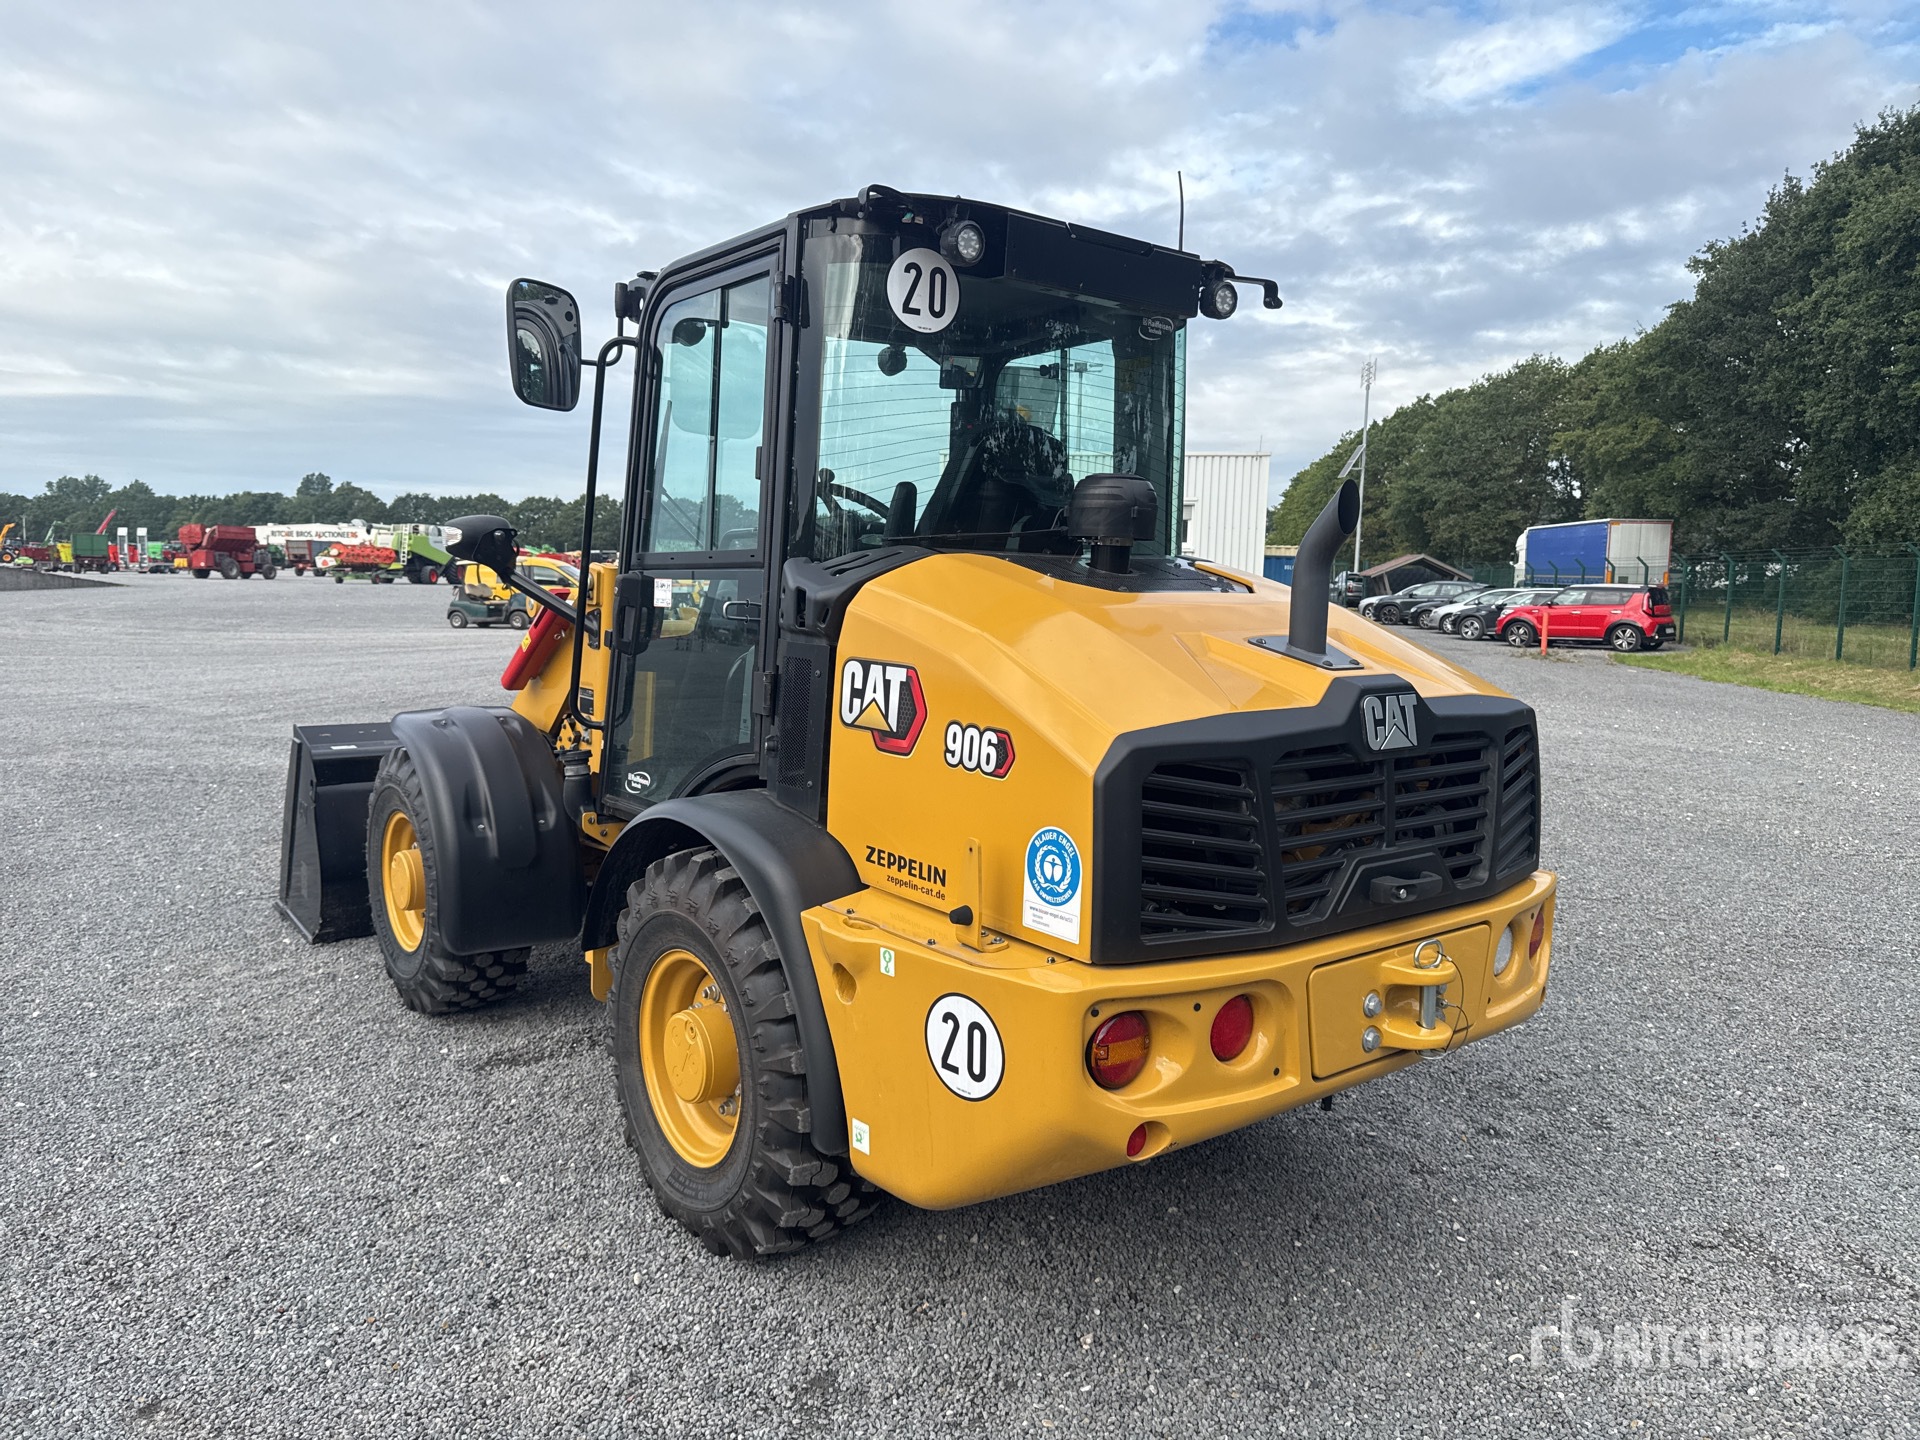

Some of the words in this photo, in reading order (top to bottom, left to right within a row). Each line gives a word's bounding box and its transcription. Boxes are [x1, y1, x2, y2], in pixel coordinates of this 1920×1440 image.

[902, 261, 947, 319] 20
[841, 660, 907, 733] CAT
[1363, 694, 1418, 751] CAT
[945, 724, 998, 773] 906
[865, 845, 947, 888] ZEPPELIN
[1034, 831, 1057, 847] BLAUER
[1058, 834, 1076, 859] ENGEL
[886, 874, 946, 901] zeppelin-cat.de
[941, 1011, 987, 1083] 20
